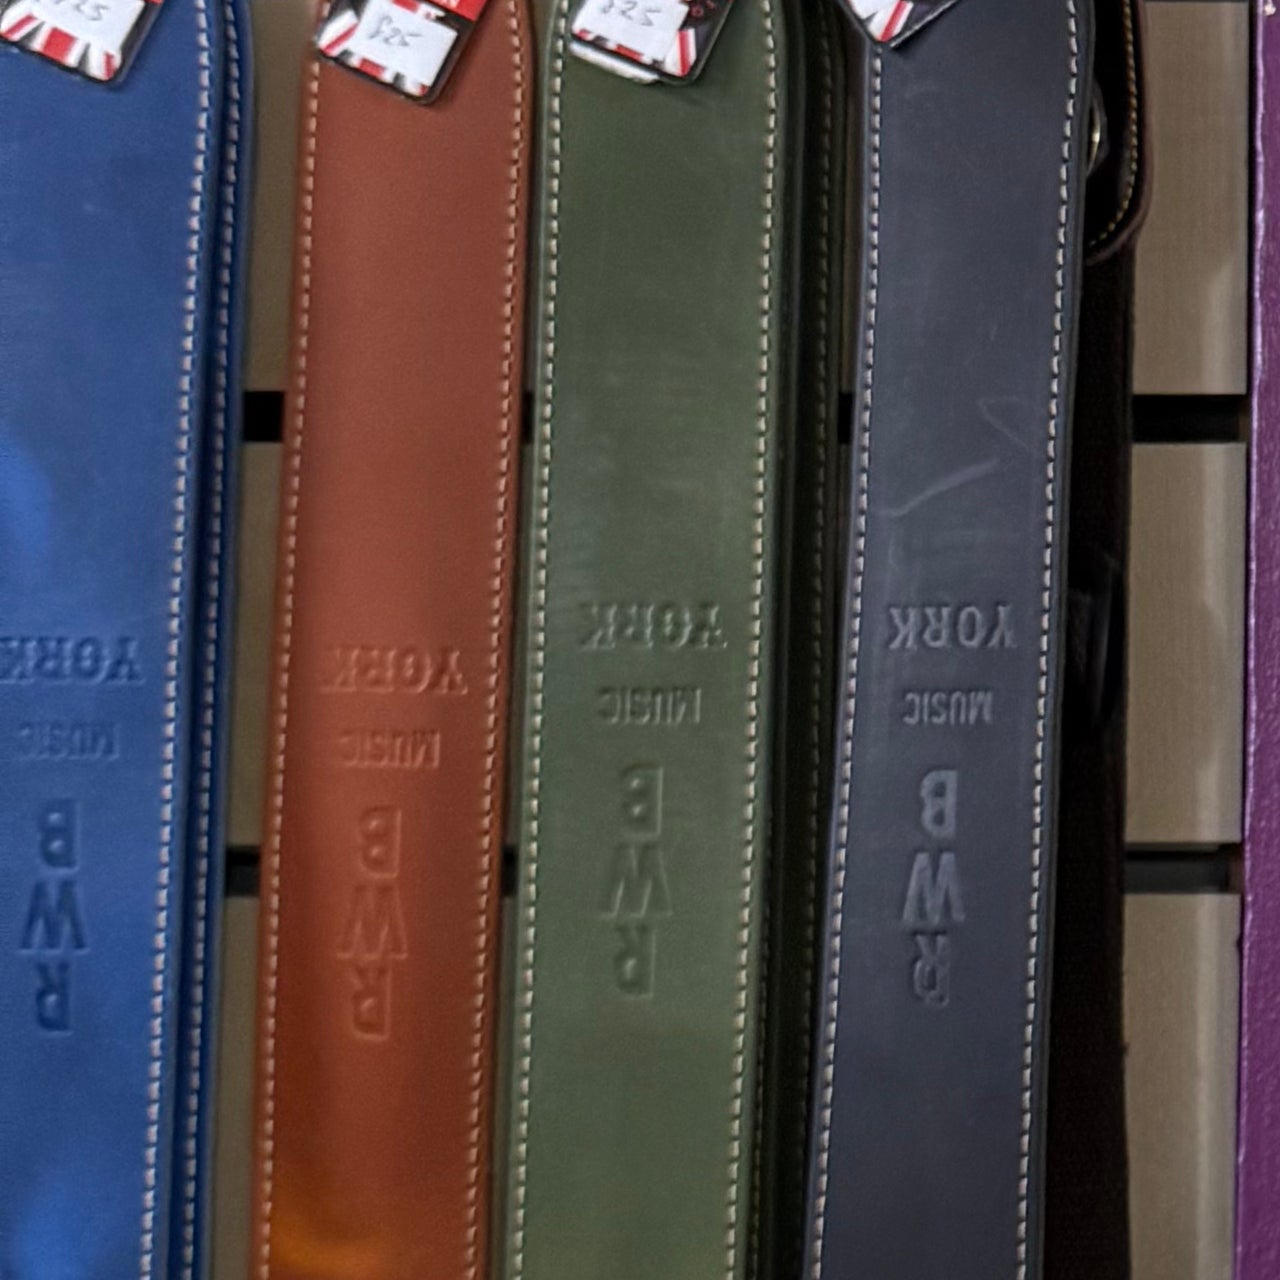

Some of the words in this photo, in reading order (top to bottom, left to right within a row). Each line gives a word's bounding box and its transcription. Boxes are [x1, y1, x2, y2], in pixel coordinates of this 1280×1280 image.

[578, 602, 729, 652] YORK
[887, 604, 1018, 650] YORK
[321, 644, 469, 696] YORK
[602, 687, 702, 727] MUSIC
[902, 689, 995, 725] MUSIC
[338, 727, 441, 769] MUSIC
